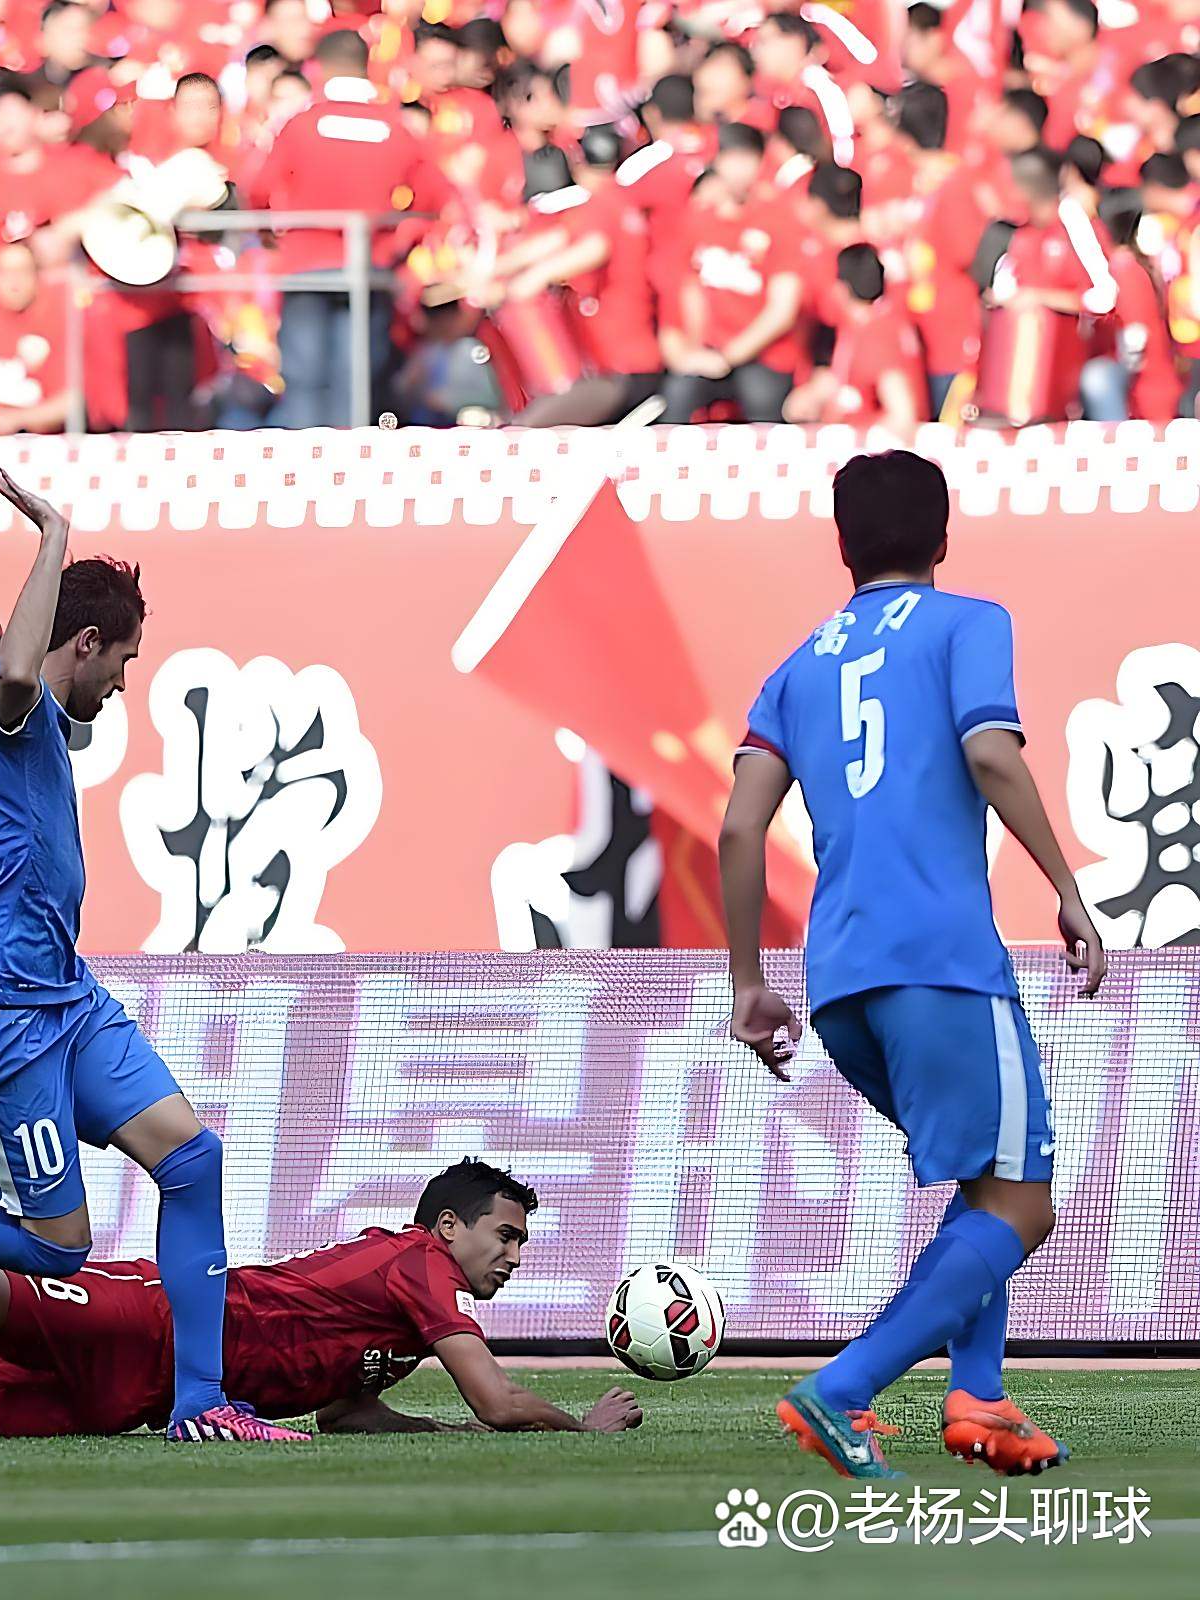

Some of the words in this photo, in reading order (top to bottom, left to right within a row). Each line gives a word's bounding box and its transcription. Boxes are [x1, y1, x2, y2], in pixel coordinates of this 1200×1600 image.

[841, 646, 886, 799] 5
[13, 1118, 66, 1179] 10
[41, 1277, 89, 1305] 8
